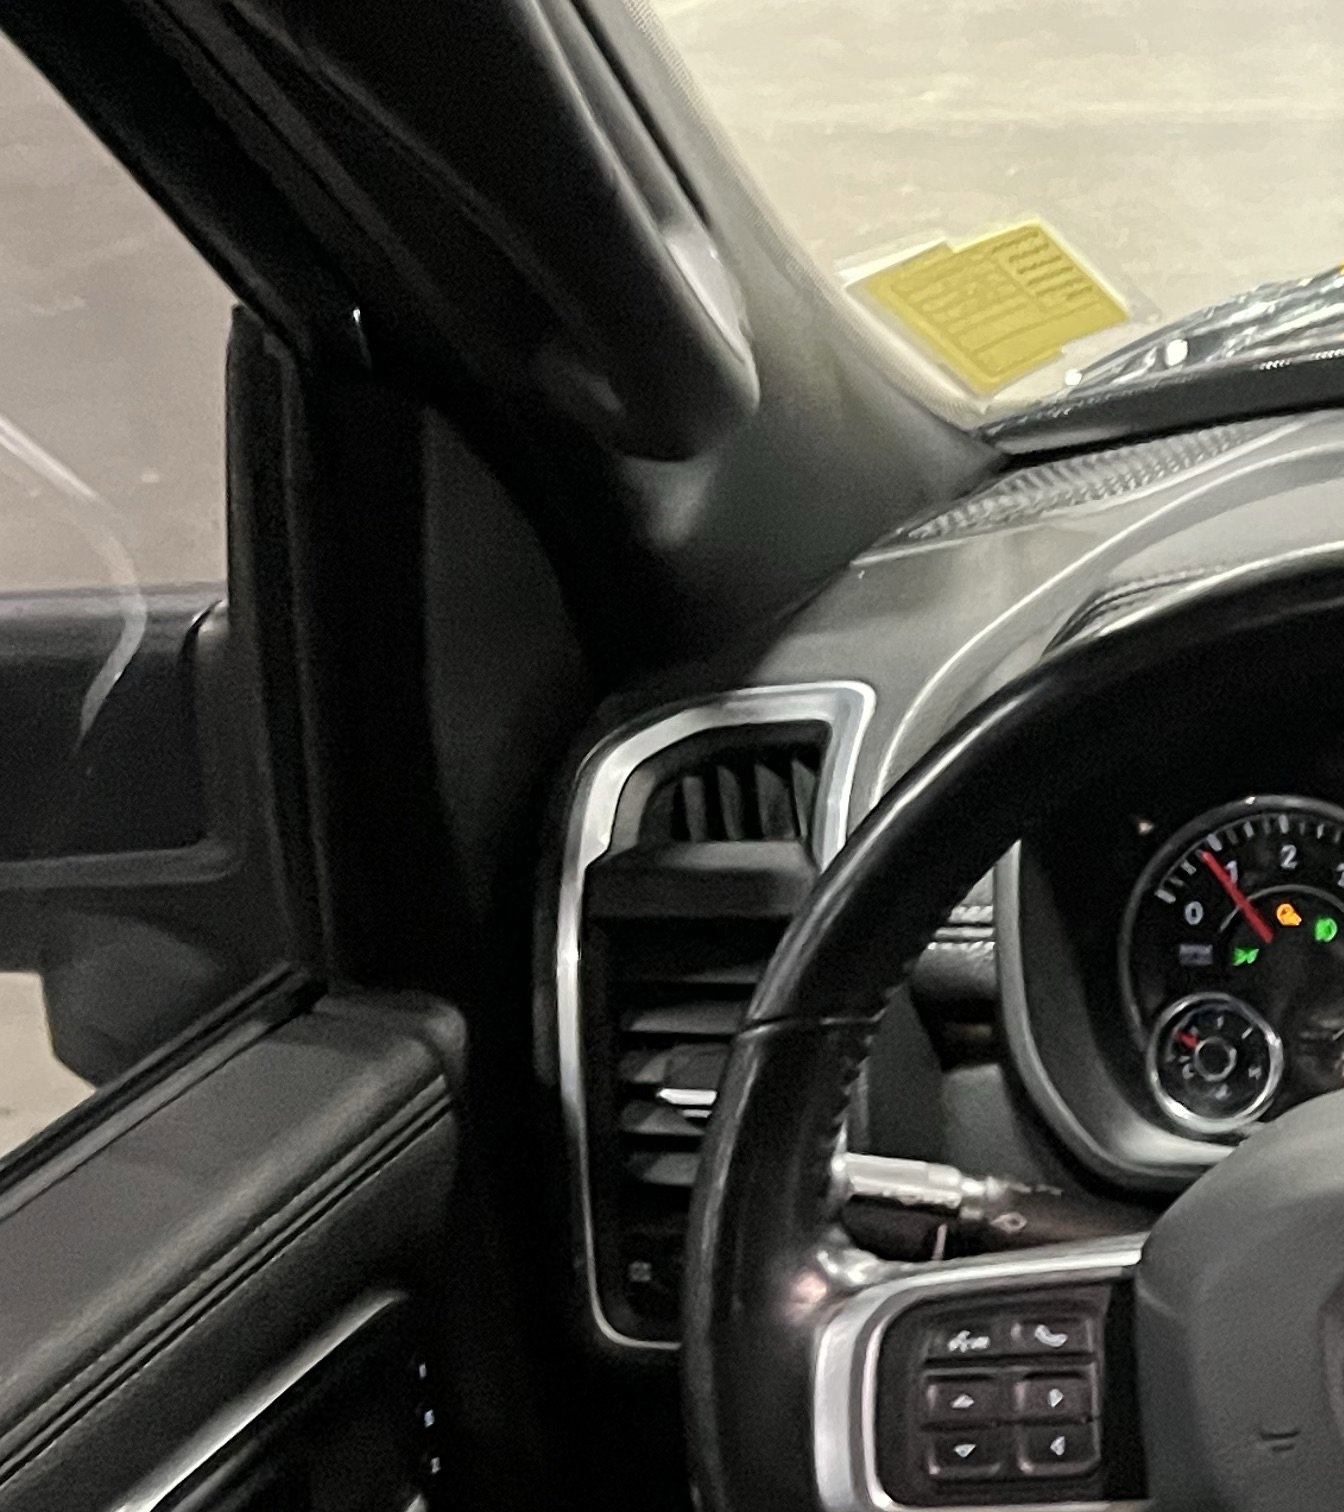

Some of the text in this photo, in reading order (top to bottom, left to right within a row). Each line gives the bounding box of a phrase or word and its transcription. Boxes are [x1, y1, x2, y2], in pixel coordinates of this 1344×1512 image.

[1280, 844, 1298, 869] 2
[1225, 860, 1239, 884] 1
[1184, 901, 1204, 926] 0
